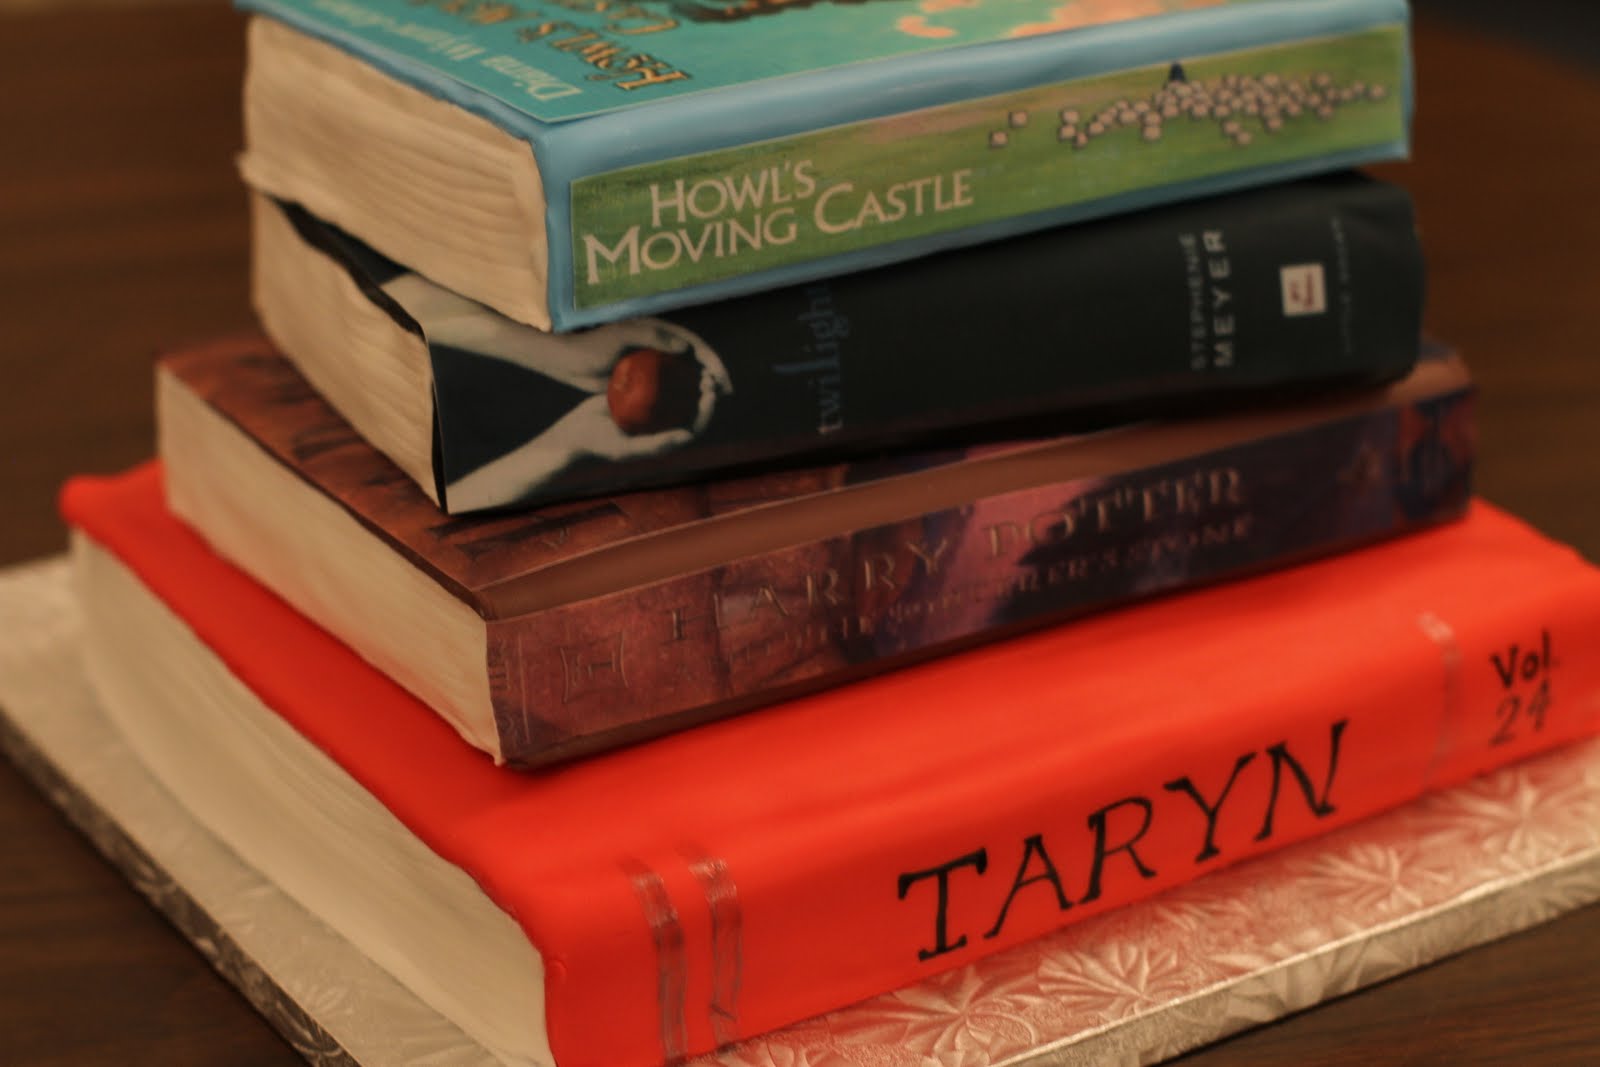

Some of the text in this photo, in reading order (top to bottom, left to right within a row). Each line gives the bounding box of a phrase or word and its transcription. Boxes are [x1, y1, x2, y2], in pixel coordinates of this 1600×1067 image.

[583, 169, 973, 286] MOVING CASTLE
[650, 160, 816, 227] HOWL'S
[1203, 230, 1236, 368] MEYER
[1488, 680, 1553, 746] 24
[897, 718, 1350, 963] TARYN
